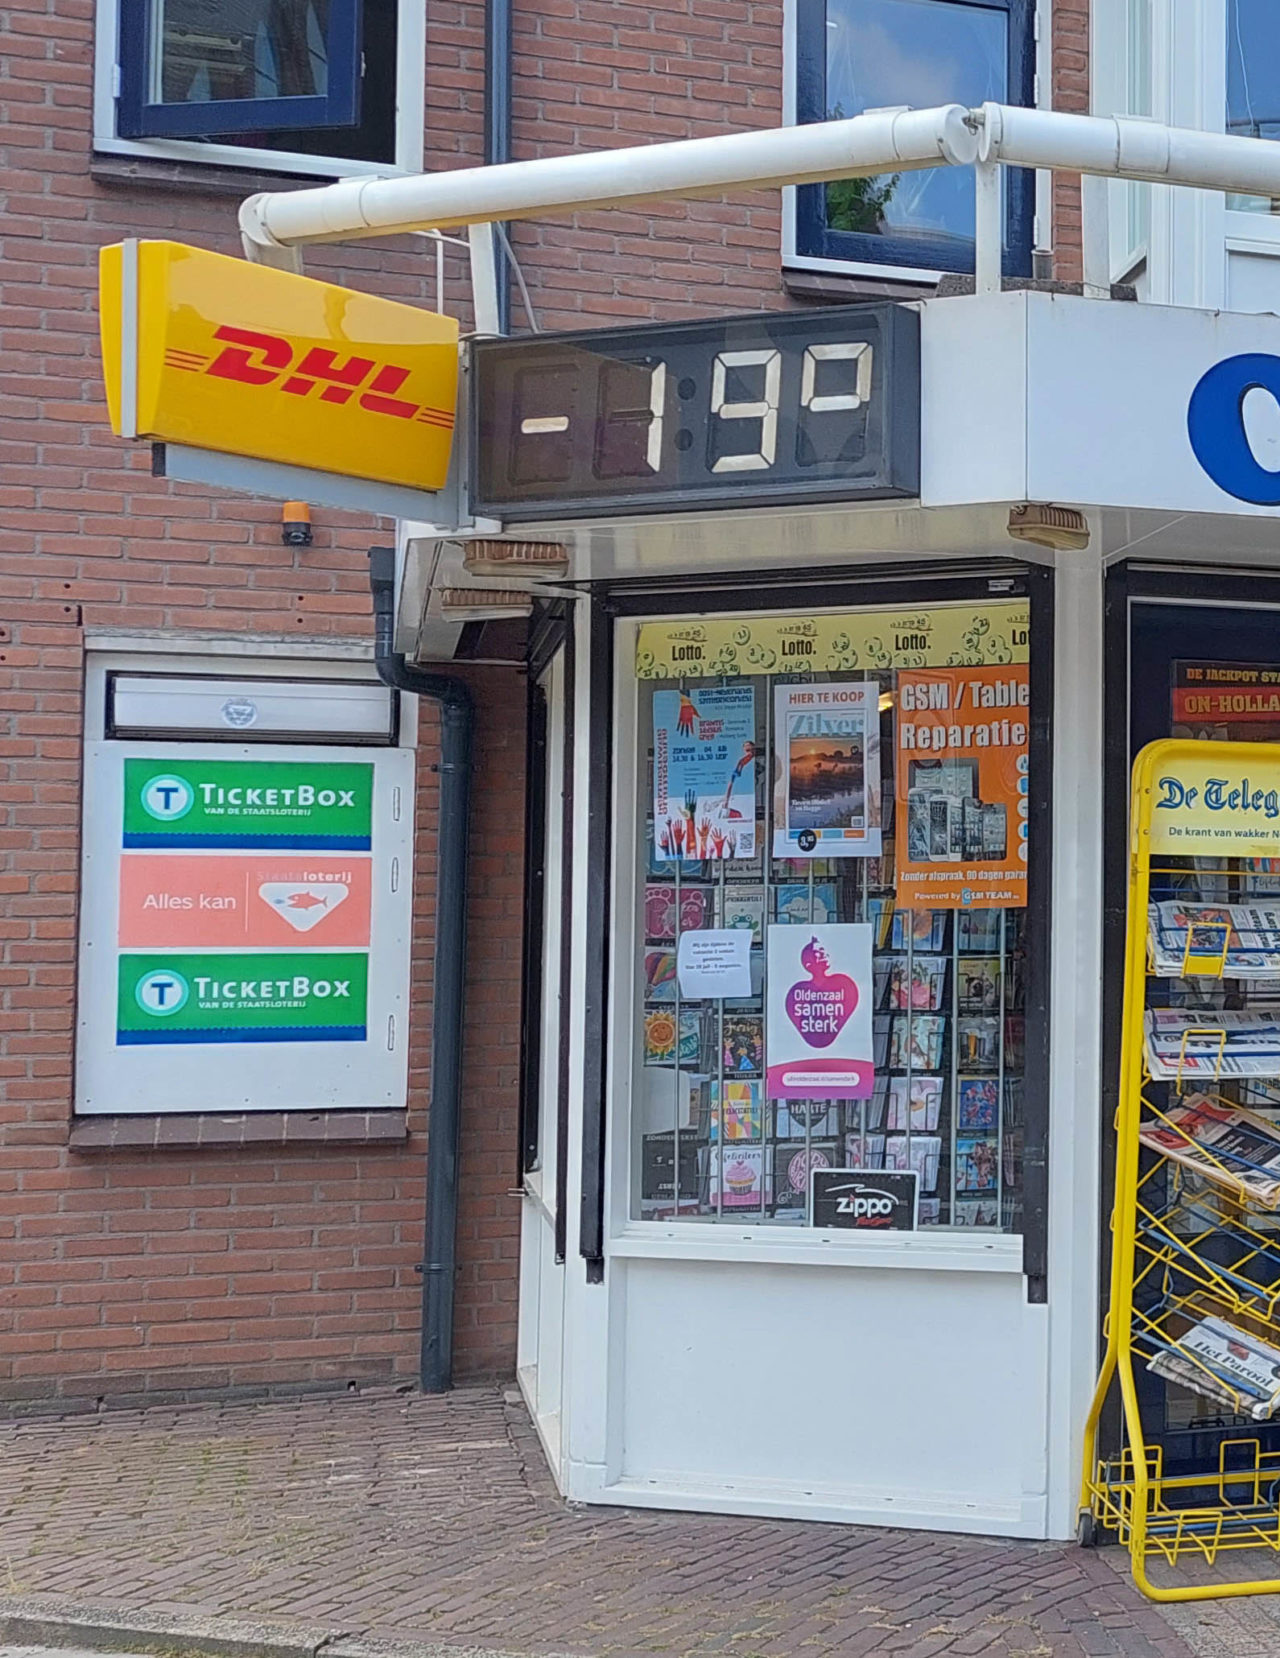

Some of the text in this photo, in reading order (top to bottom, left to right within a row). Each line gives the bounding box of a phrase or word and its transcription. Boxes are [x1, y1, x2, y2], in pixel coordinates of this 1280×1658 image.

[205, 324, 423, 420] DHL
[1186, 668, 1203, 680] DE
[1206, 668, 1259, 682] JACKPOT
[789, 691, 865, 704] HIER TE KOOP
[900, 682, 949, 712] GSM
[954, 681, 966, 709] /
[789, 713, 864, 737] Zilver
[900, 719, 1026, 751] Reparatie
[1155, 776, 1198, 810] De
[203, 807, 225, 815] VAN
[242, 808, 311, 816] STAATSLOTERIJ
[1168, 826, 1183, 836] De
[1185, 826, 1212, 837] krant
[1214, 829, 1232, 838] van
[1234, 828, 1270, 839] wakker
[143, 892, 237, 911] Alles kan
[985, 891, 1012, 899] TEAM
[794, 988, 844, 1001] Oldenzaal
[198, 1000, 306, 1009] VAN DE STAATSLOTERIJ
[794, 1003, 844, 1016] samen
[801, 1016, 838, 1033] sterk
[1221, 1356, 1275, 1388] Parool
